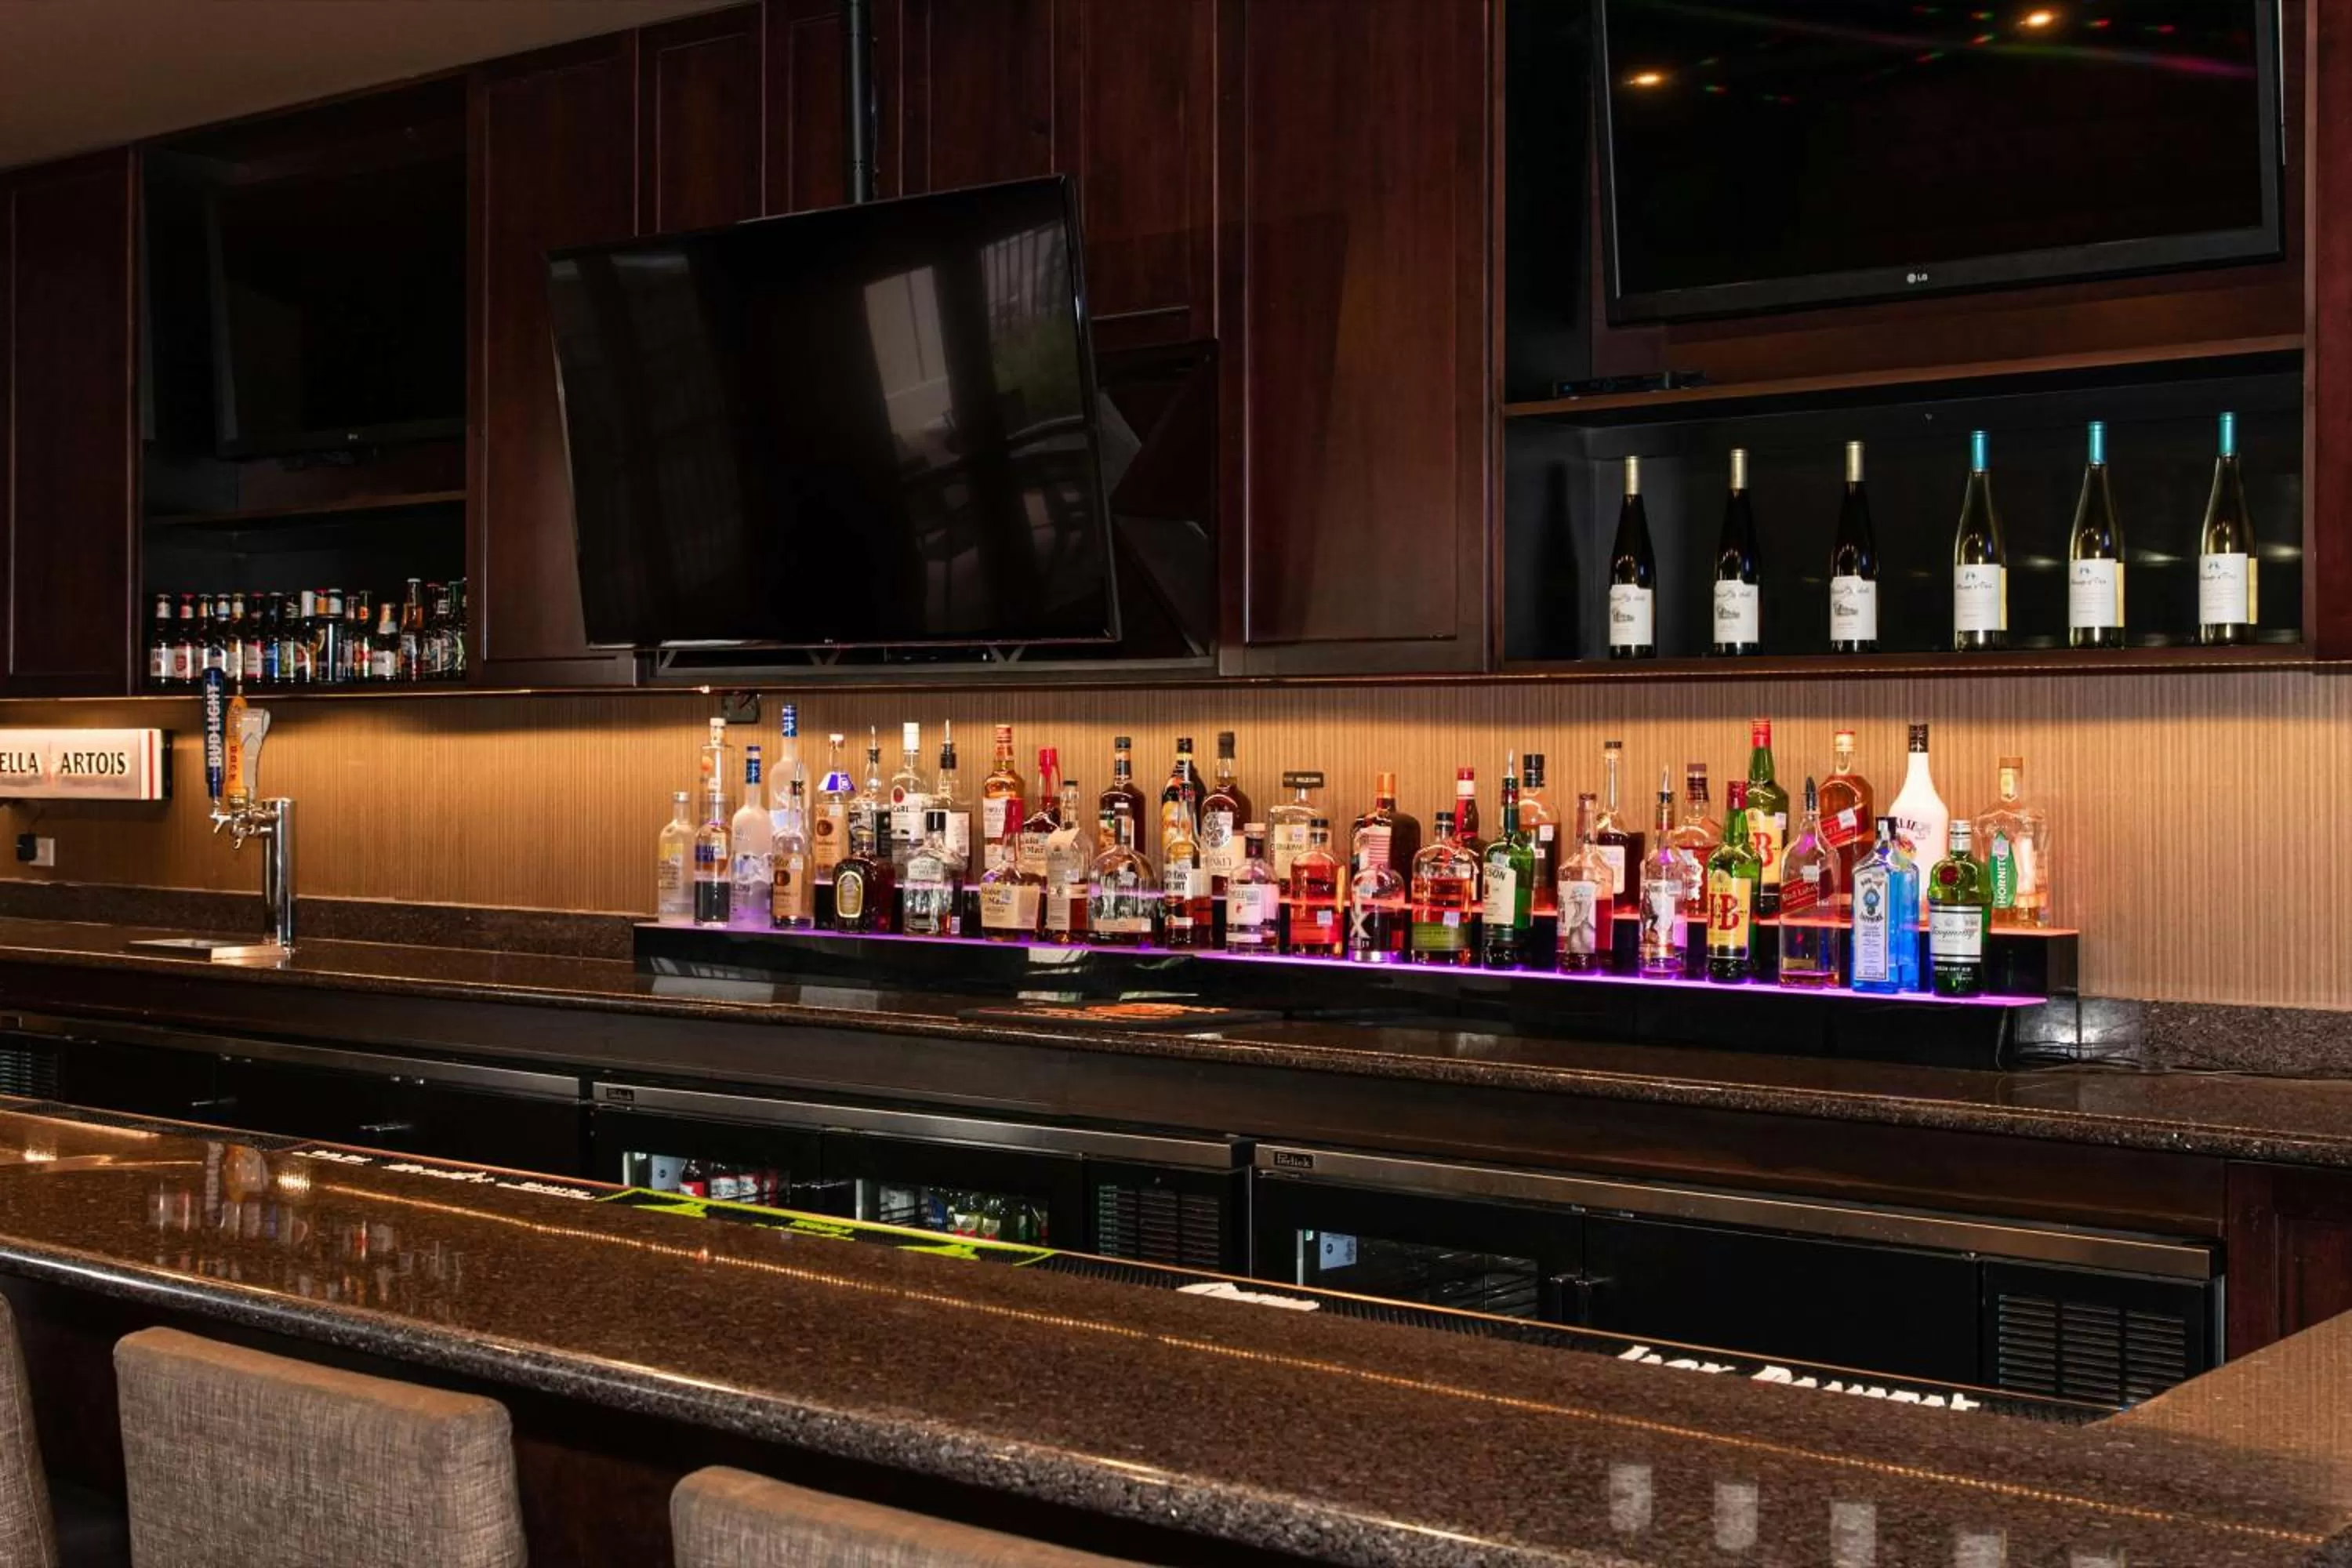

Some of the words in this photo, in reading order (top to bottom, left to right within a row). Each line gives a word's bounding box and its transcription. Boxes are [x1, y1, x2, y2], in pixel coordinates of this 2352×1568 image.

[206, 682, 220, 731] LIGHT
[60, 752, 127, 775] ARTOIS
[207, 733, 222, 768] BUD
